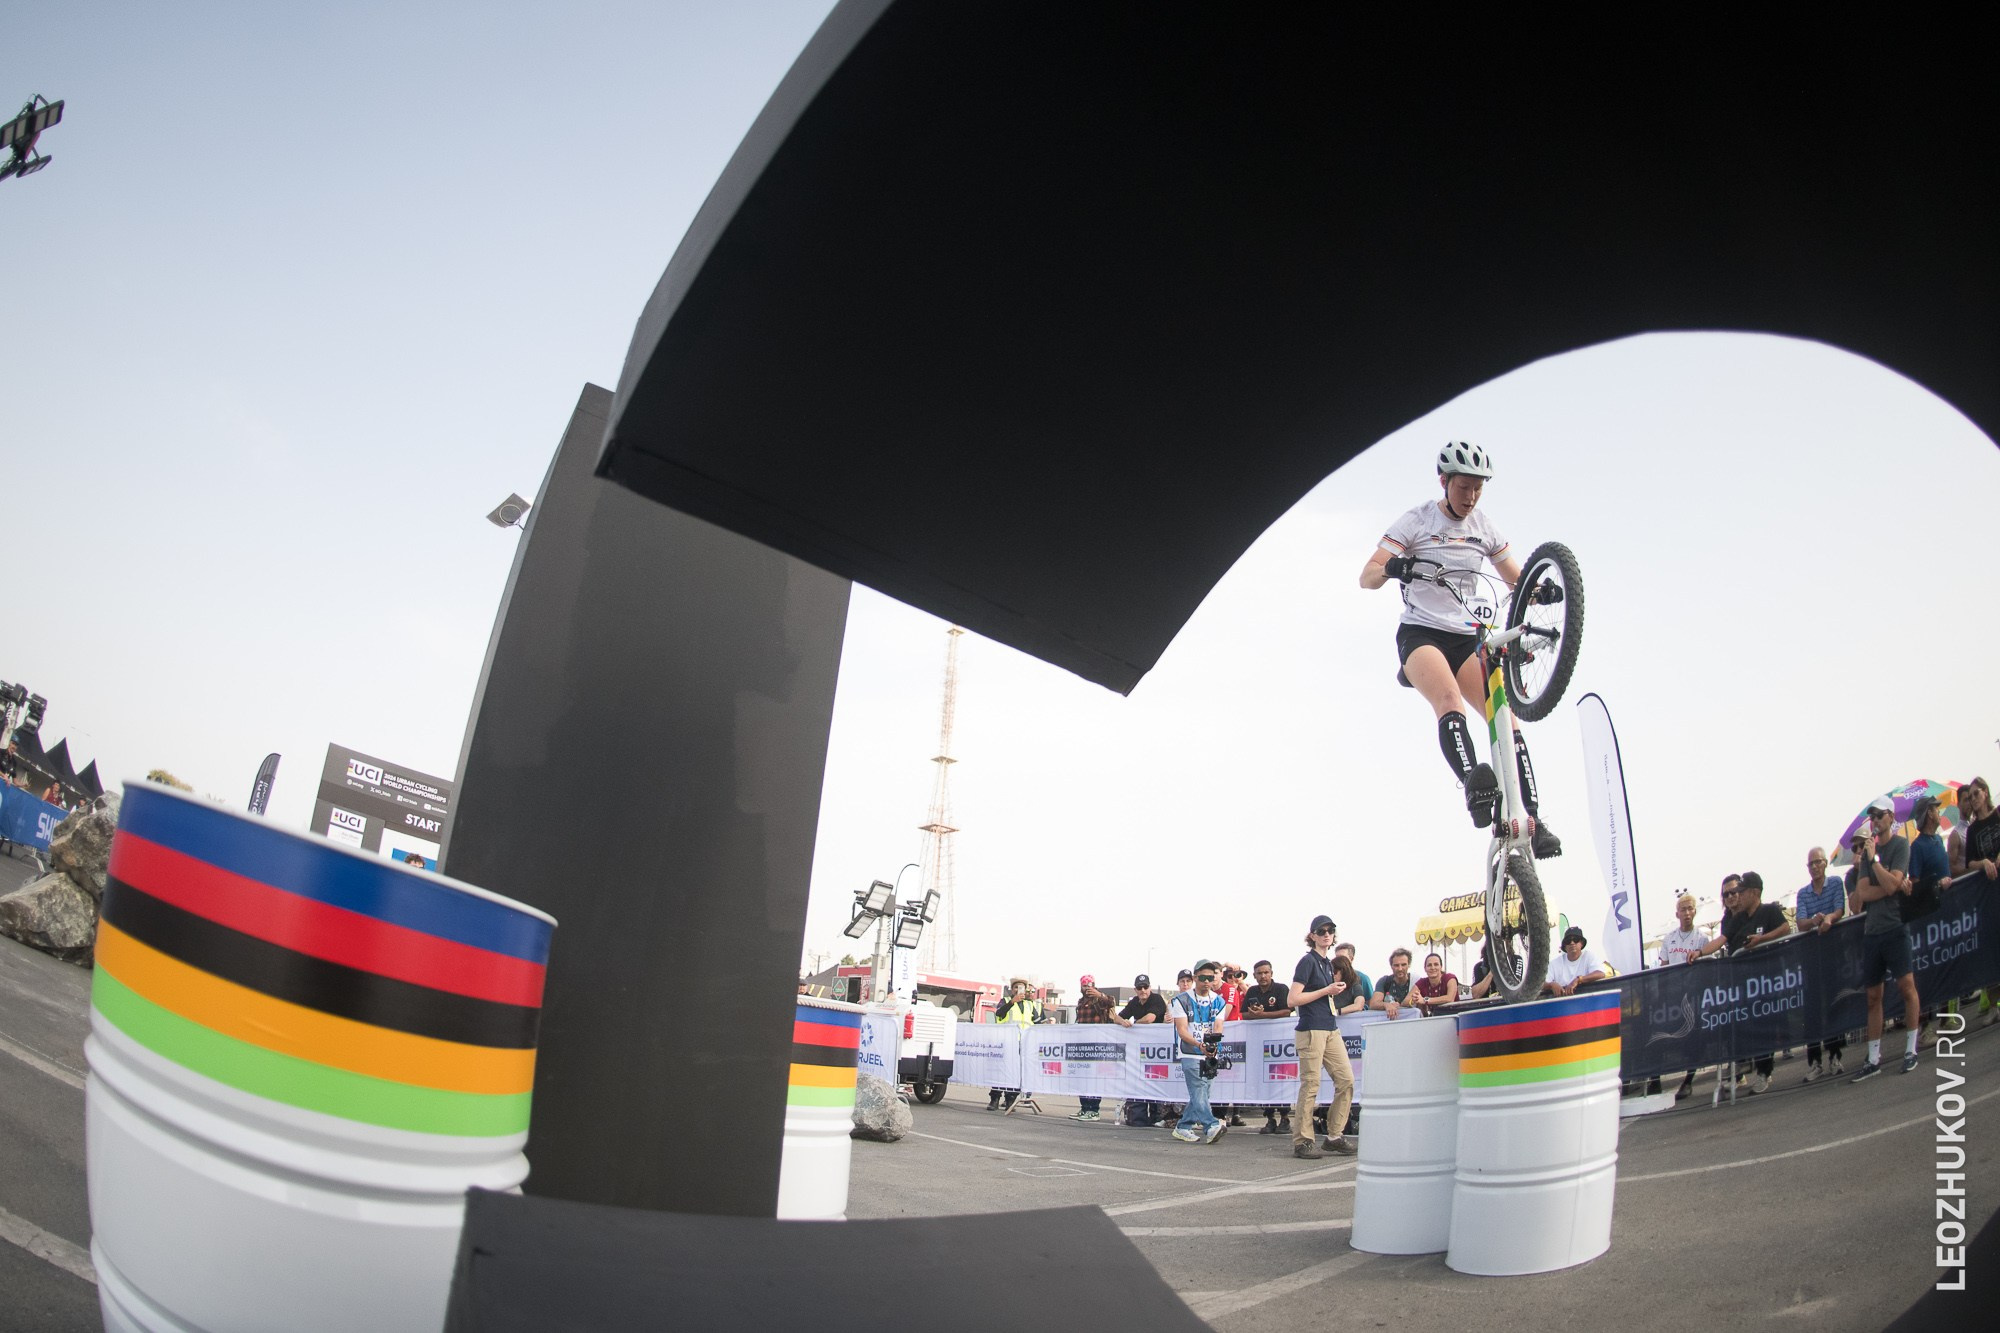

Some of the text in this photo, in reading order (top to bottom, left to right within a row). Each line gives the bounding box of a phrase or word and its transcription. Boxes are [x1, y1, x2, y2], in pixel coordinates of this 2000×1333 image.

[1473, 606, 1493, 619] 4D
[354, 763, 380, 782] UCI
[382, 779, 447, 803] WORLD CHAMPIONSHIPS
[396, 777, 415, 787] URBAN
[415, 783, 438, 794] CYCLING
[339, 812, 361, 828] UCI
[404, 813, 442, 833] START
[1440, 893, 1478, 912] CAMEL
[1926, 907, 1978, 946] Dhabi
[1932, 931, 1978, 966] Council
[1701, 985, 1740, 1009] Abu
[1746, 965, 1803, 999] Dhabi
[1701, 1006, 1749, 1031] Sports
[1752, 989, 1804, 1018] Council
[1043, 1045, 1063, 1057] UCI
[1145, 1046, 1171, 1060] UCI
